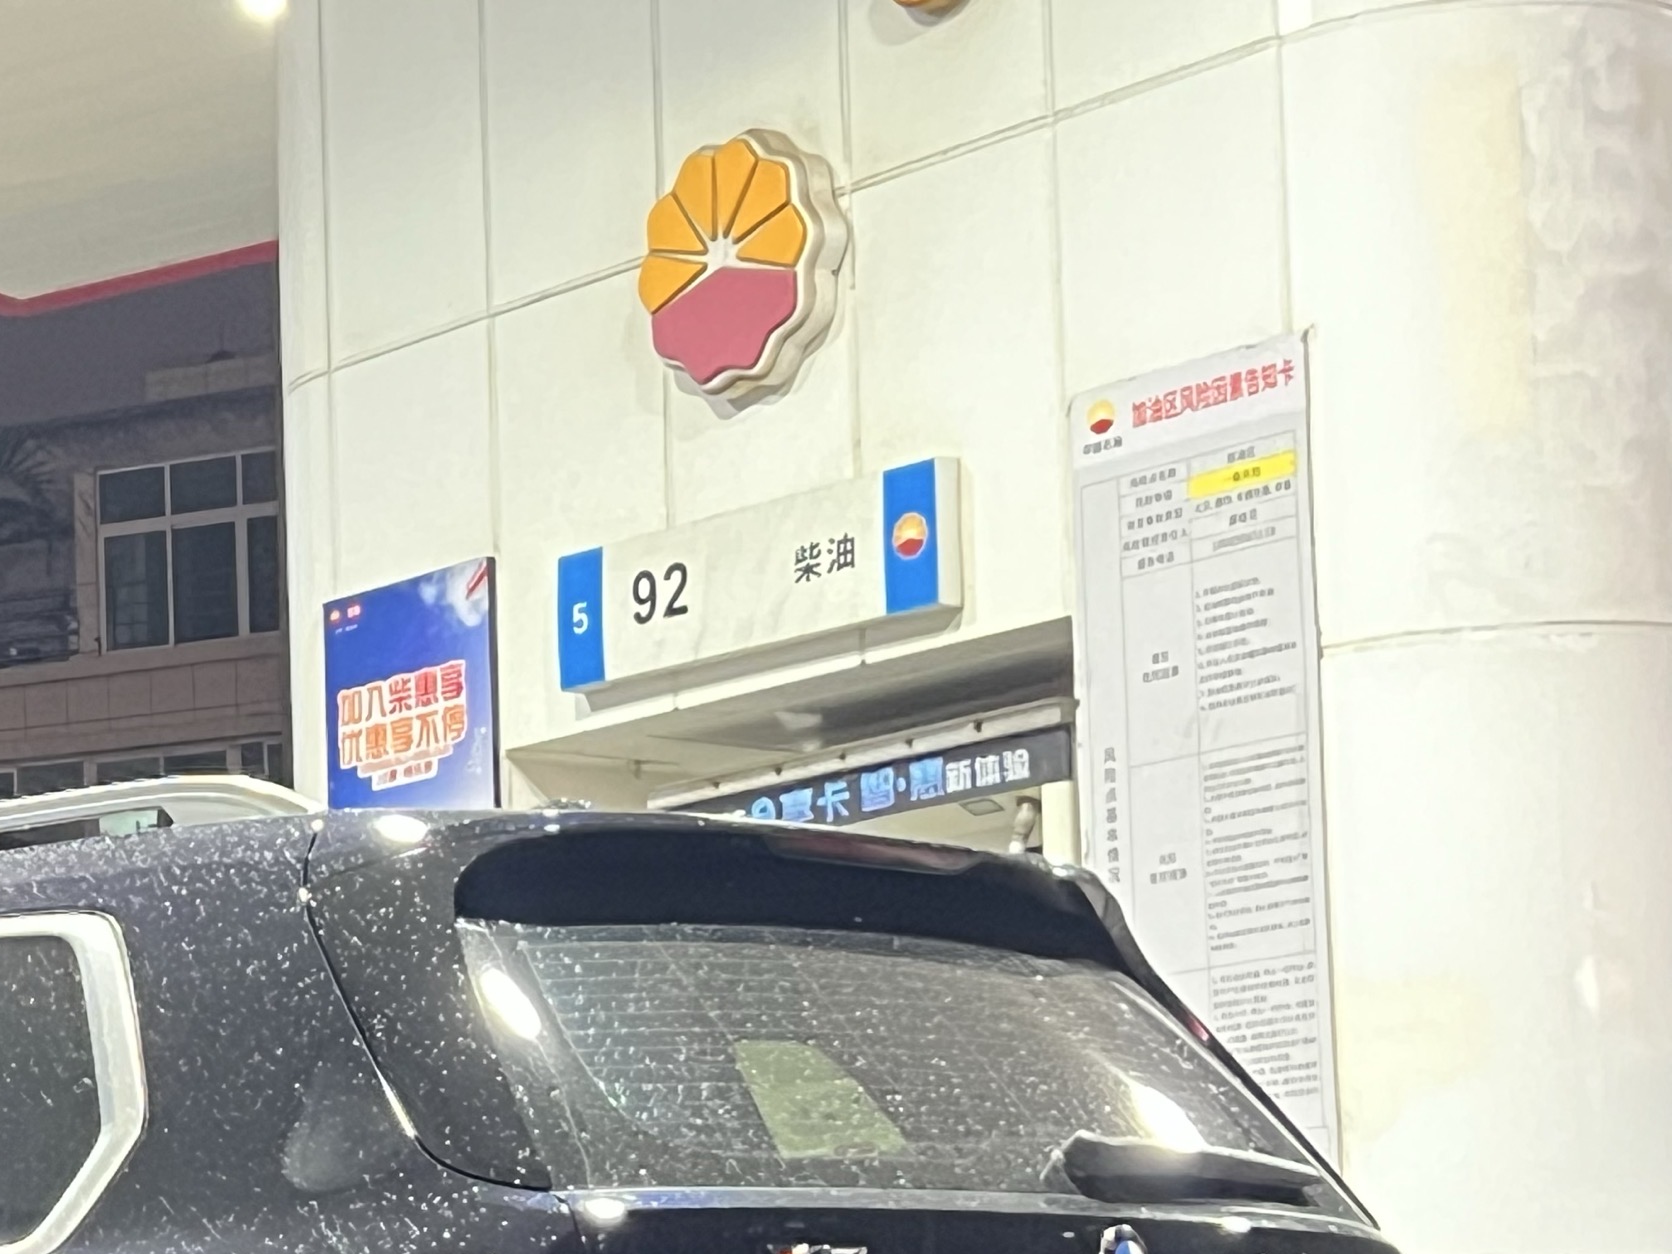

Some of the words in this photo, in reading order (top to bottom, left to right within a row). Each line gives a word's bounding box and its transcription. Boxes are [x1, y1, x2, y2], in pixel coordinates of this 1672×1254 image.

[794, 532, 856, 584] 柴油
[572, 602, 589, 634] 5
[632, 562, 689, 625] 92
[340, 663, 464, 727] 加入柴惠享
[342, 704, 465, 766] 优惠享不停
